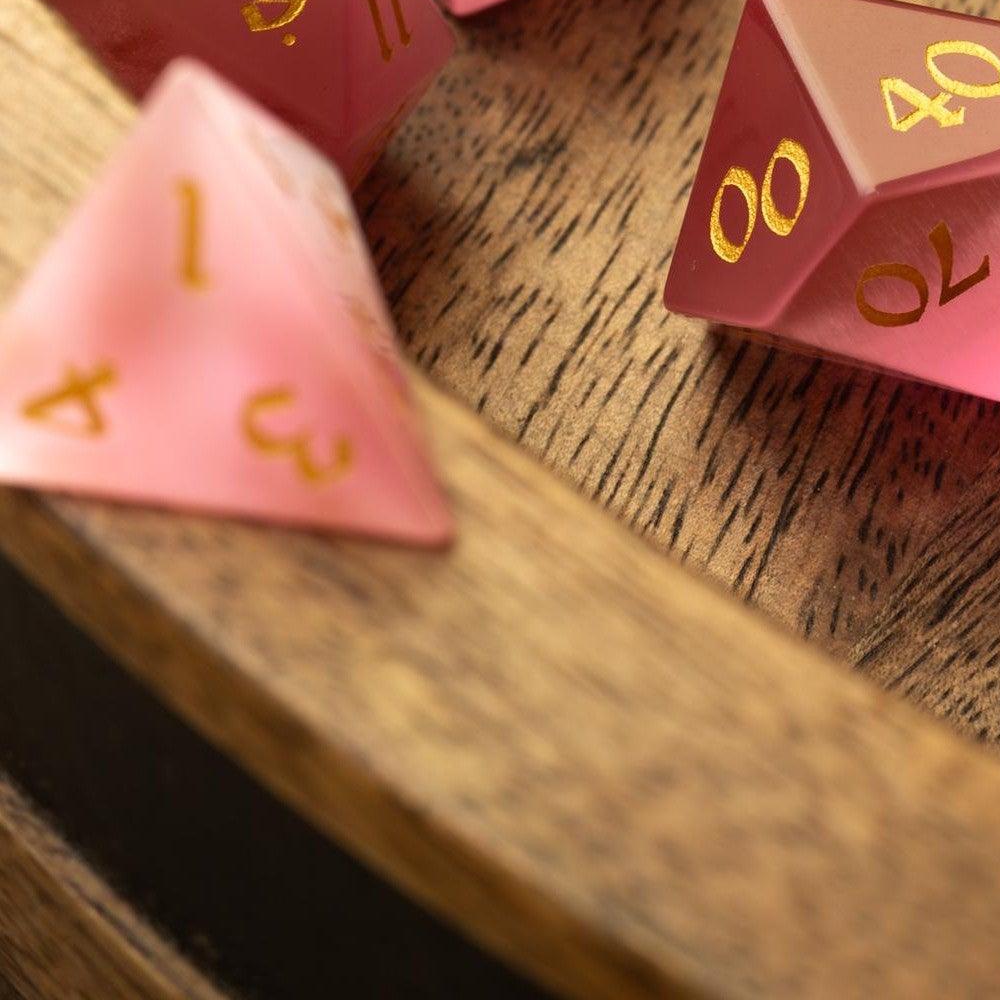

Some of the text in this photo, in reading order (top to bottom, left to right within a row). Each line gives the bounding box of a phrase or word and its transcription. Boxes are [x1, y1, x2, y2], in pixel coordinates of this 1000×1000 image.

[175, 174, 210, 291] 1
[710, 138, 811, 264] 00
[240, 386, 354, 490] 3
